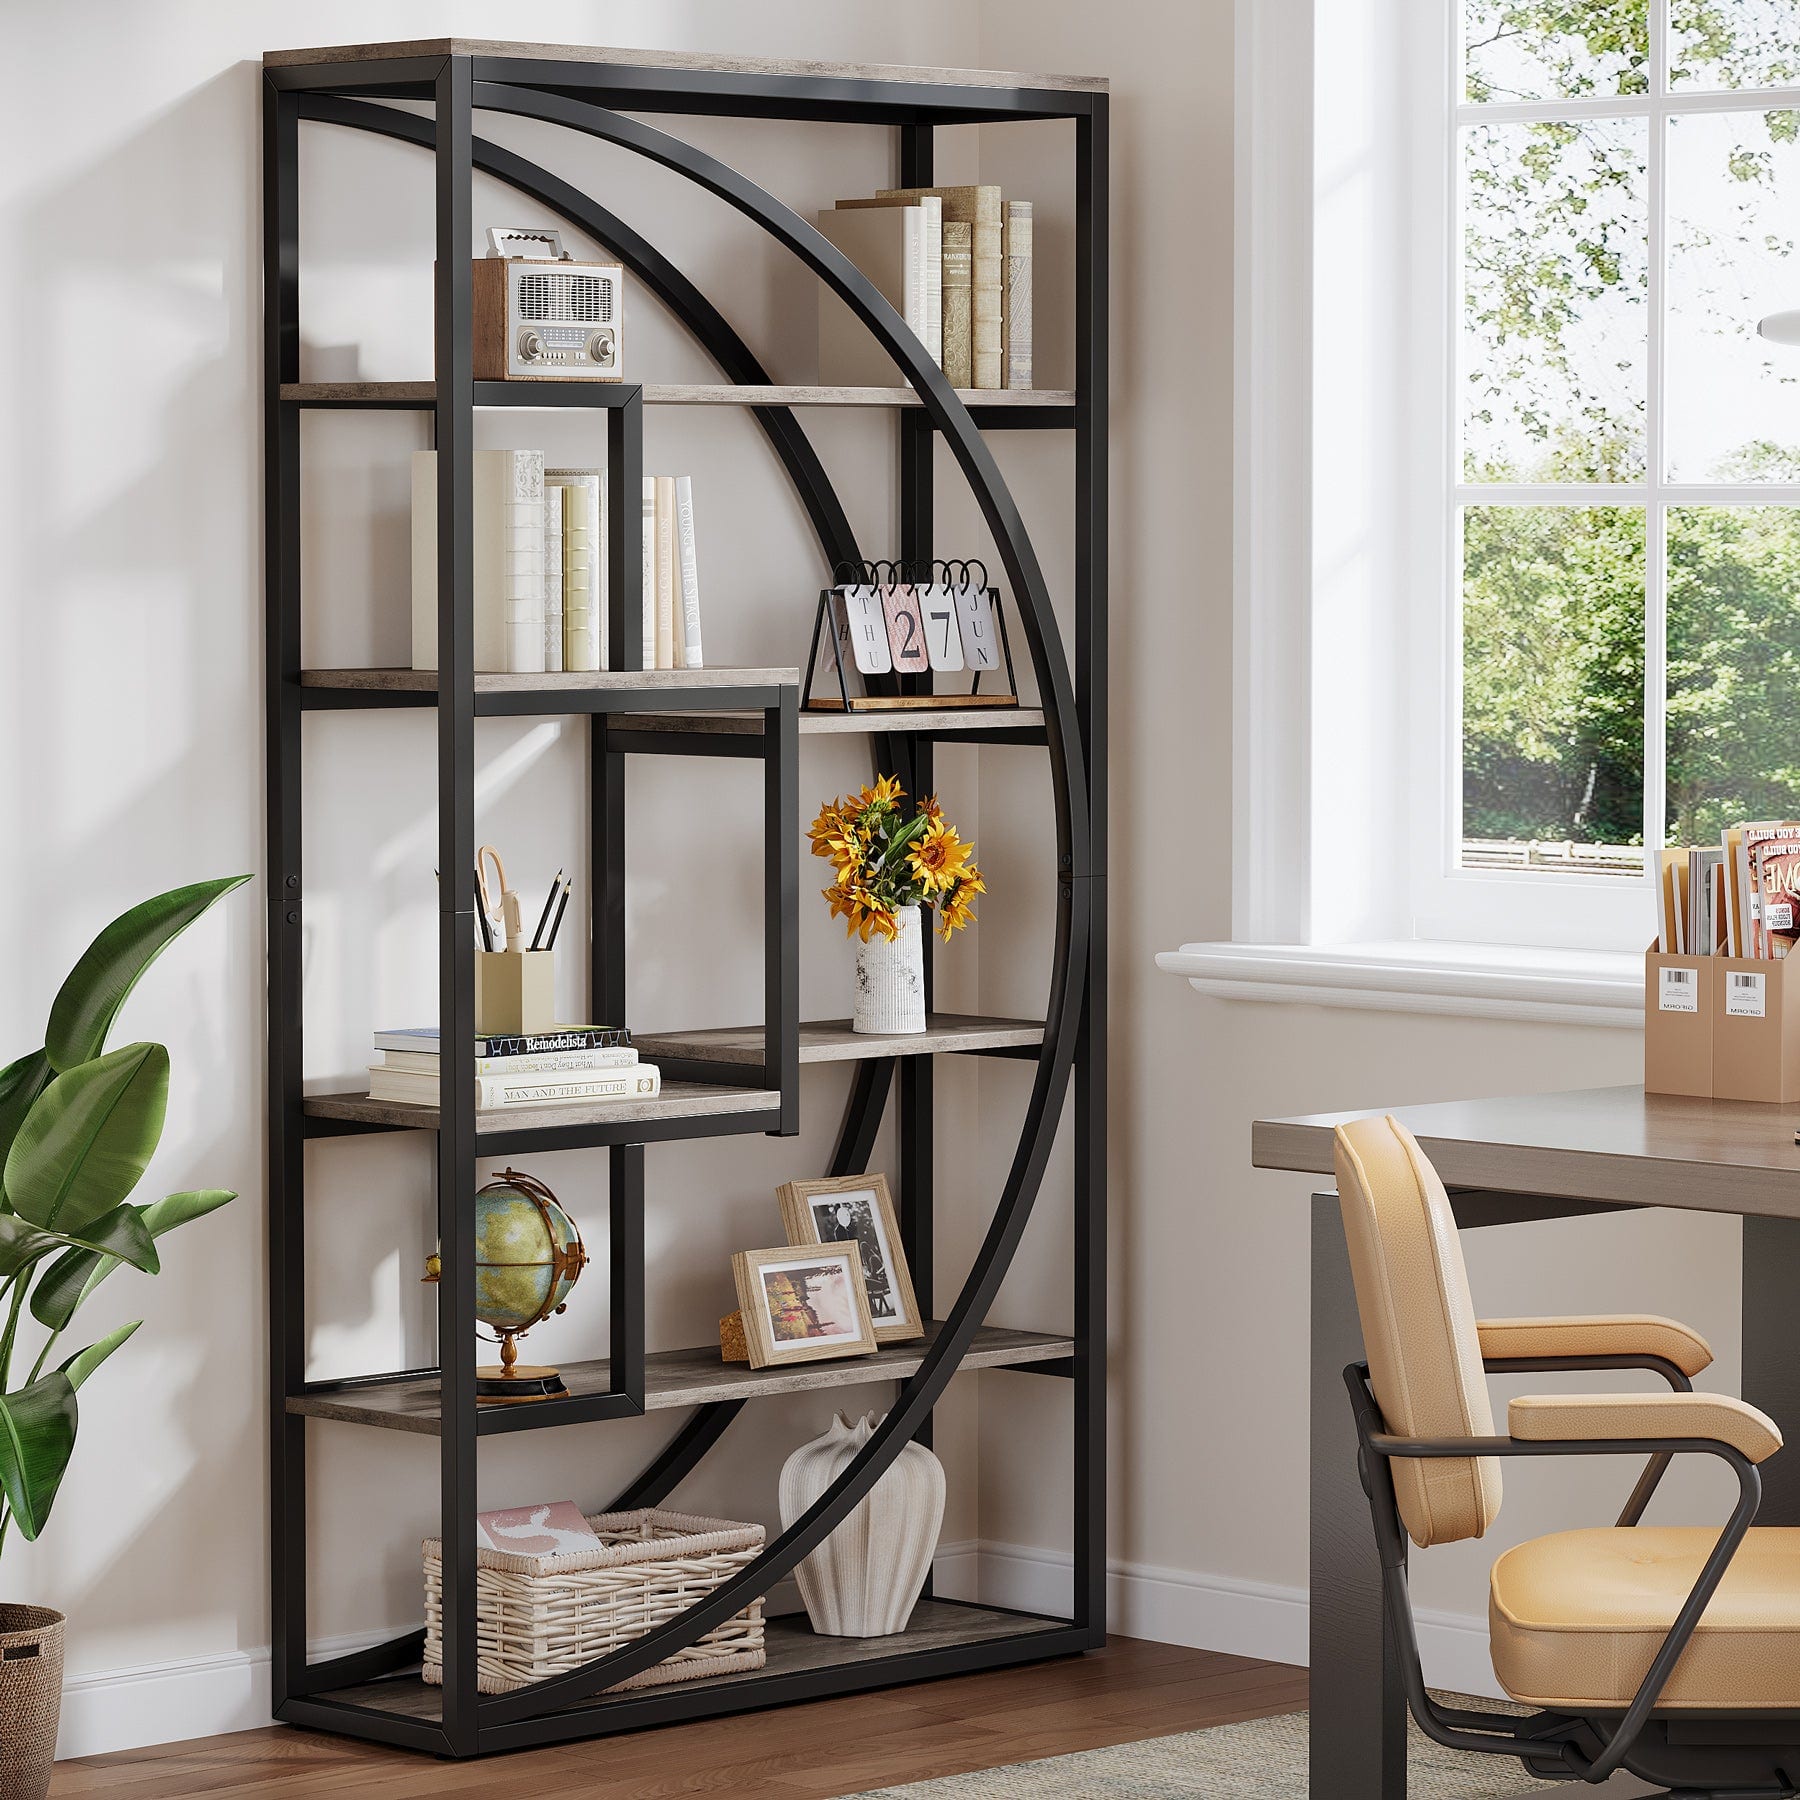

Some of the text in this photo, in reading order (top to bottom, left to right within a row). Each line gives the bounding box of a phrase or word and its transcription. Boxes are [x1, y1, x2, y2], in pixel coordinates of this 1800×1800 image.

[680, 499, 699, 631] YOUNG THE SHACK
[660, 593, 669, 632] JUMBO
[526, 1034, 587, 1051] Remodelista
[574, 1060, 593, 1070] What
[504, 1082, 627, 1101] MAN AND THE FUTURE
